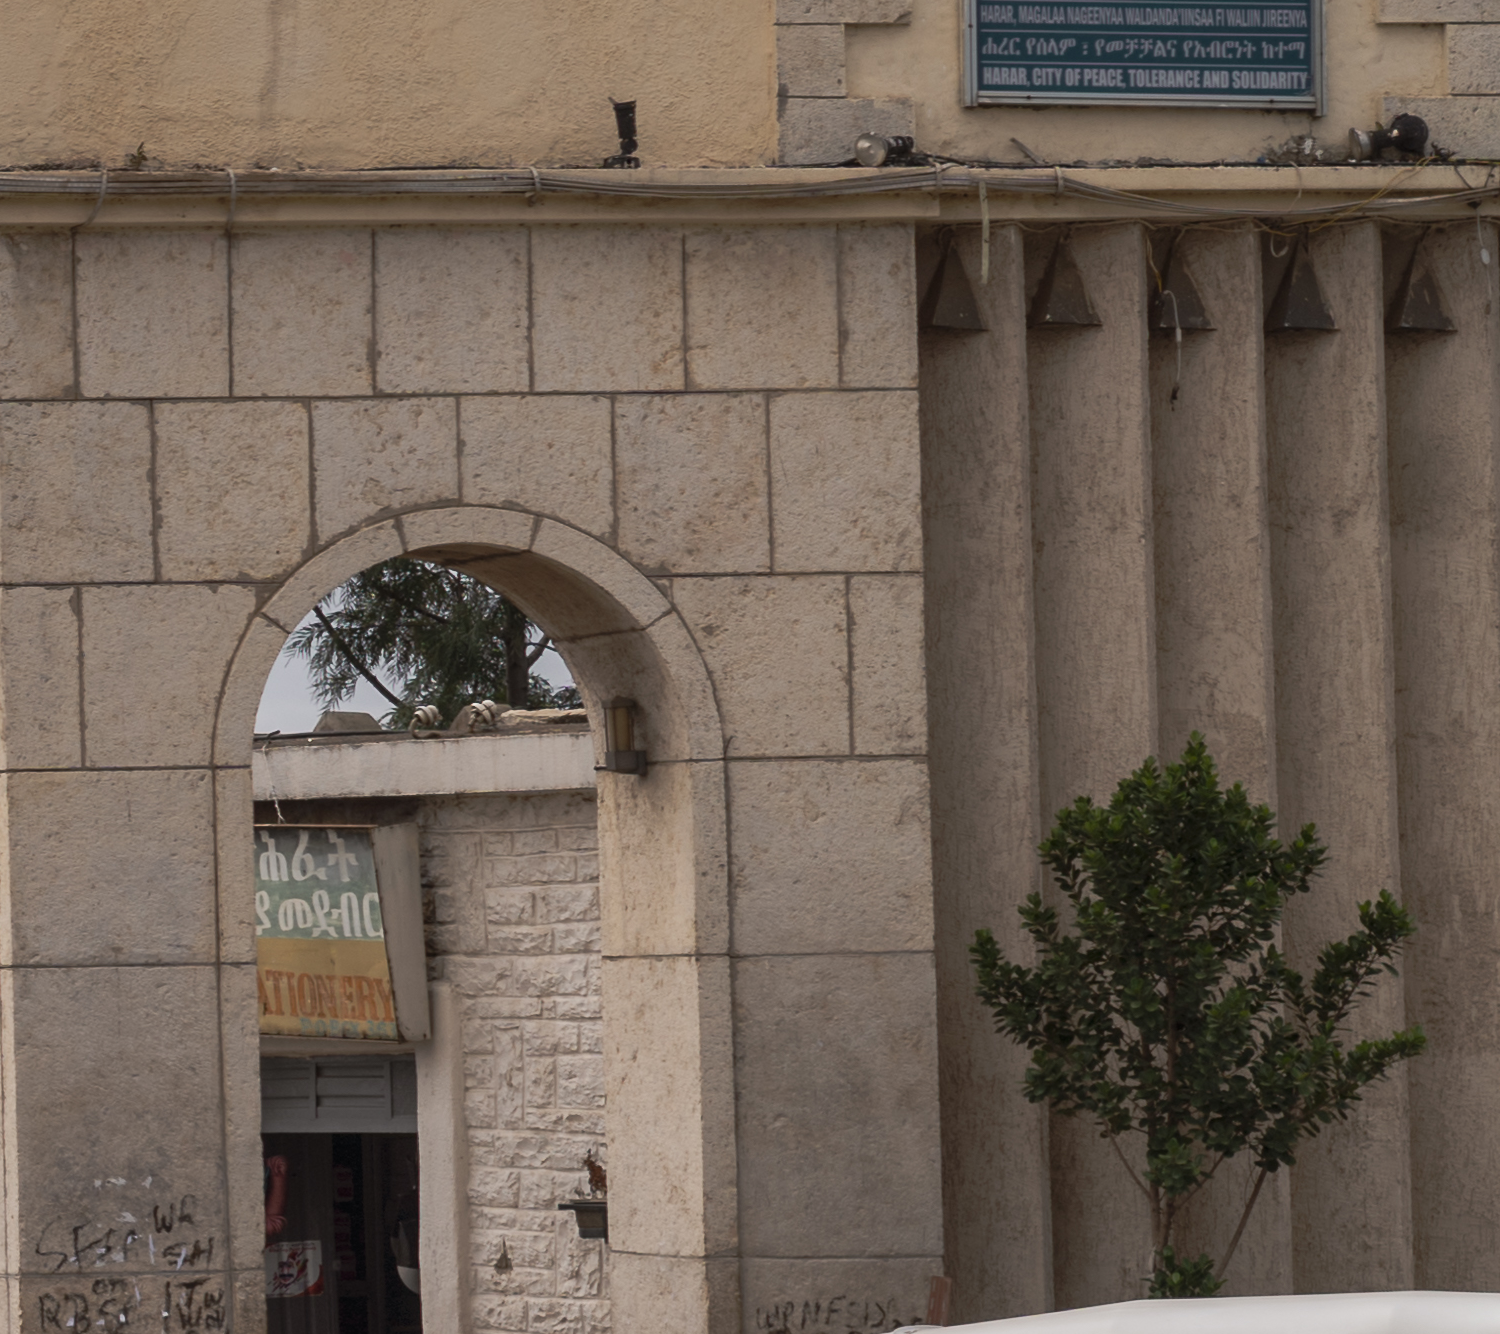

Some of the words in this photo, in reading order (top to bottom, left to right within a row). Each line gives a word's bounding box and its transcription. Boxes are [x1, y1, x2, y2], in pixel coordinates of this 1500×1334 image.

[980, 5, 1016, 27] HARAR,
[1019, 6, 1065, 24] MAGALAA
[1067, 7, 1124, 25] NAGEENYAA
[1216, 9, 1225, 27] FI
[1262, 9, 1308, 28] JIREENYA
[982, 37, 1021, 56] ሐረር
[1026, 38, 1077, 56] የሰላም
[1261, 40, 1306, 59] ከተማ
[983, 67, 1030, 88] HARAR,
[1032, 68, 1062, 86] CITY
[1065, 68, 1081, 86] OF
[1083, 69, 1126, 89] PEACE,
[1128, 69, 1200, 88] TOLERANCE
[1203, 71, 1228, 88] AND
[1232, 71, 1309, 90] SOLIDARITY
